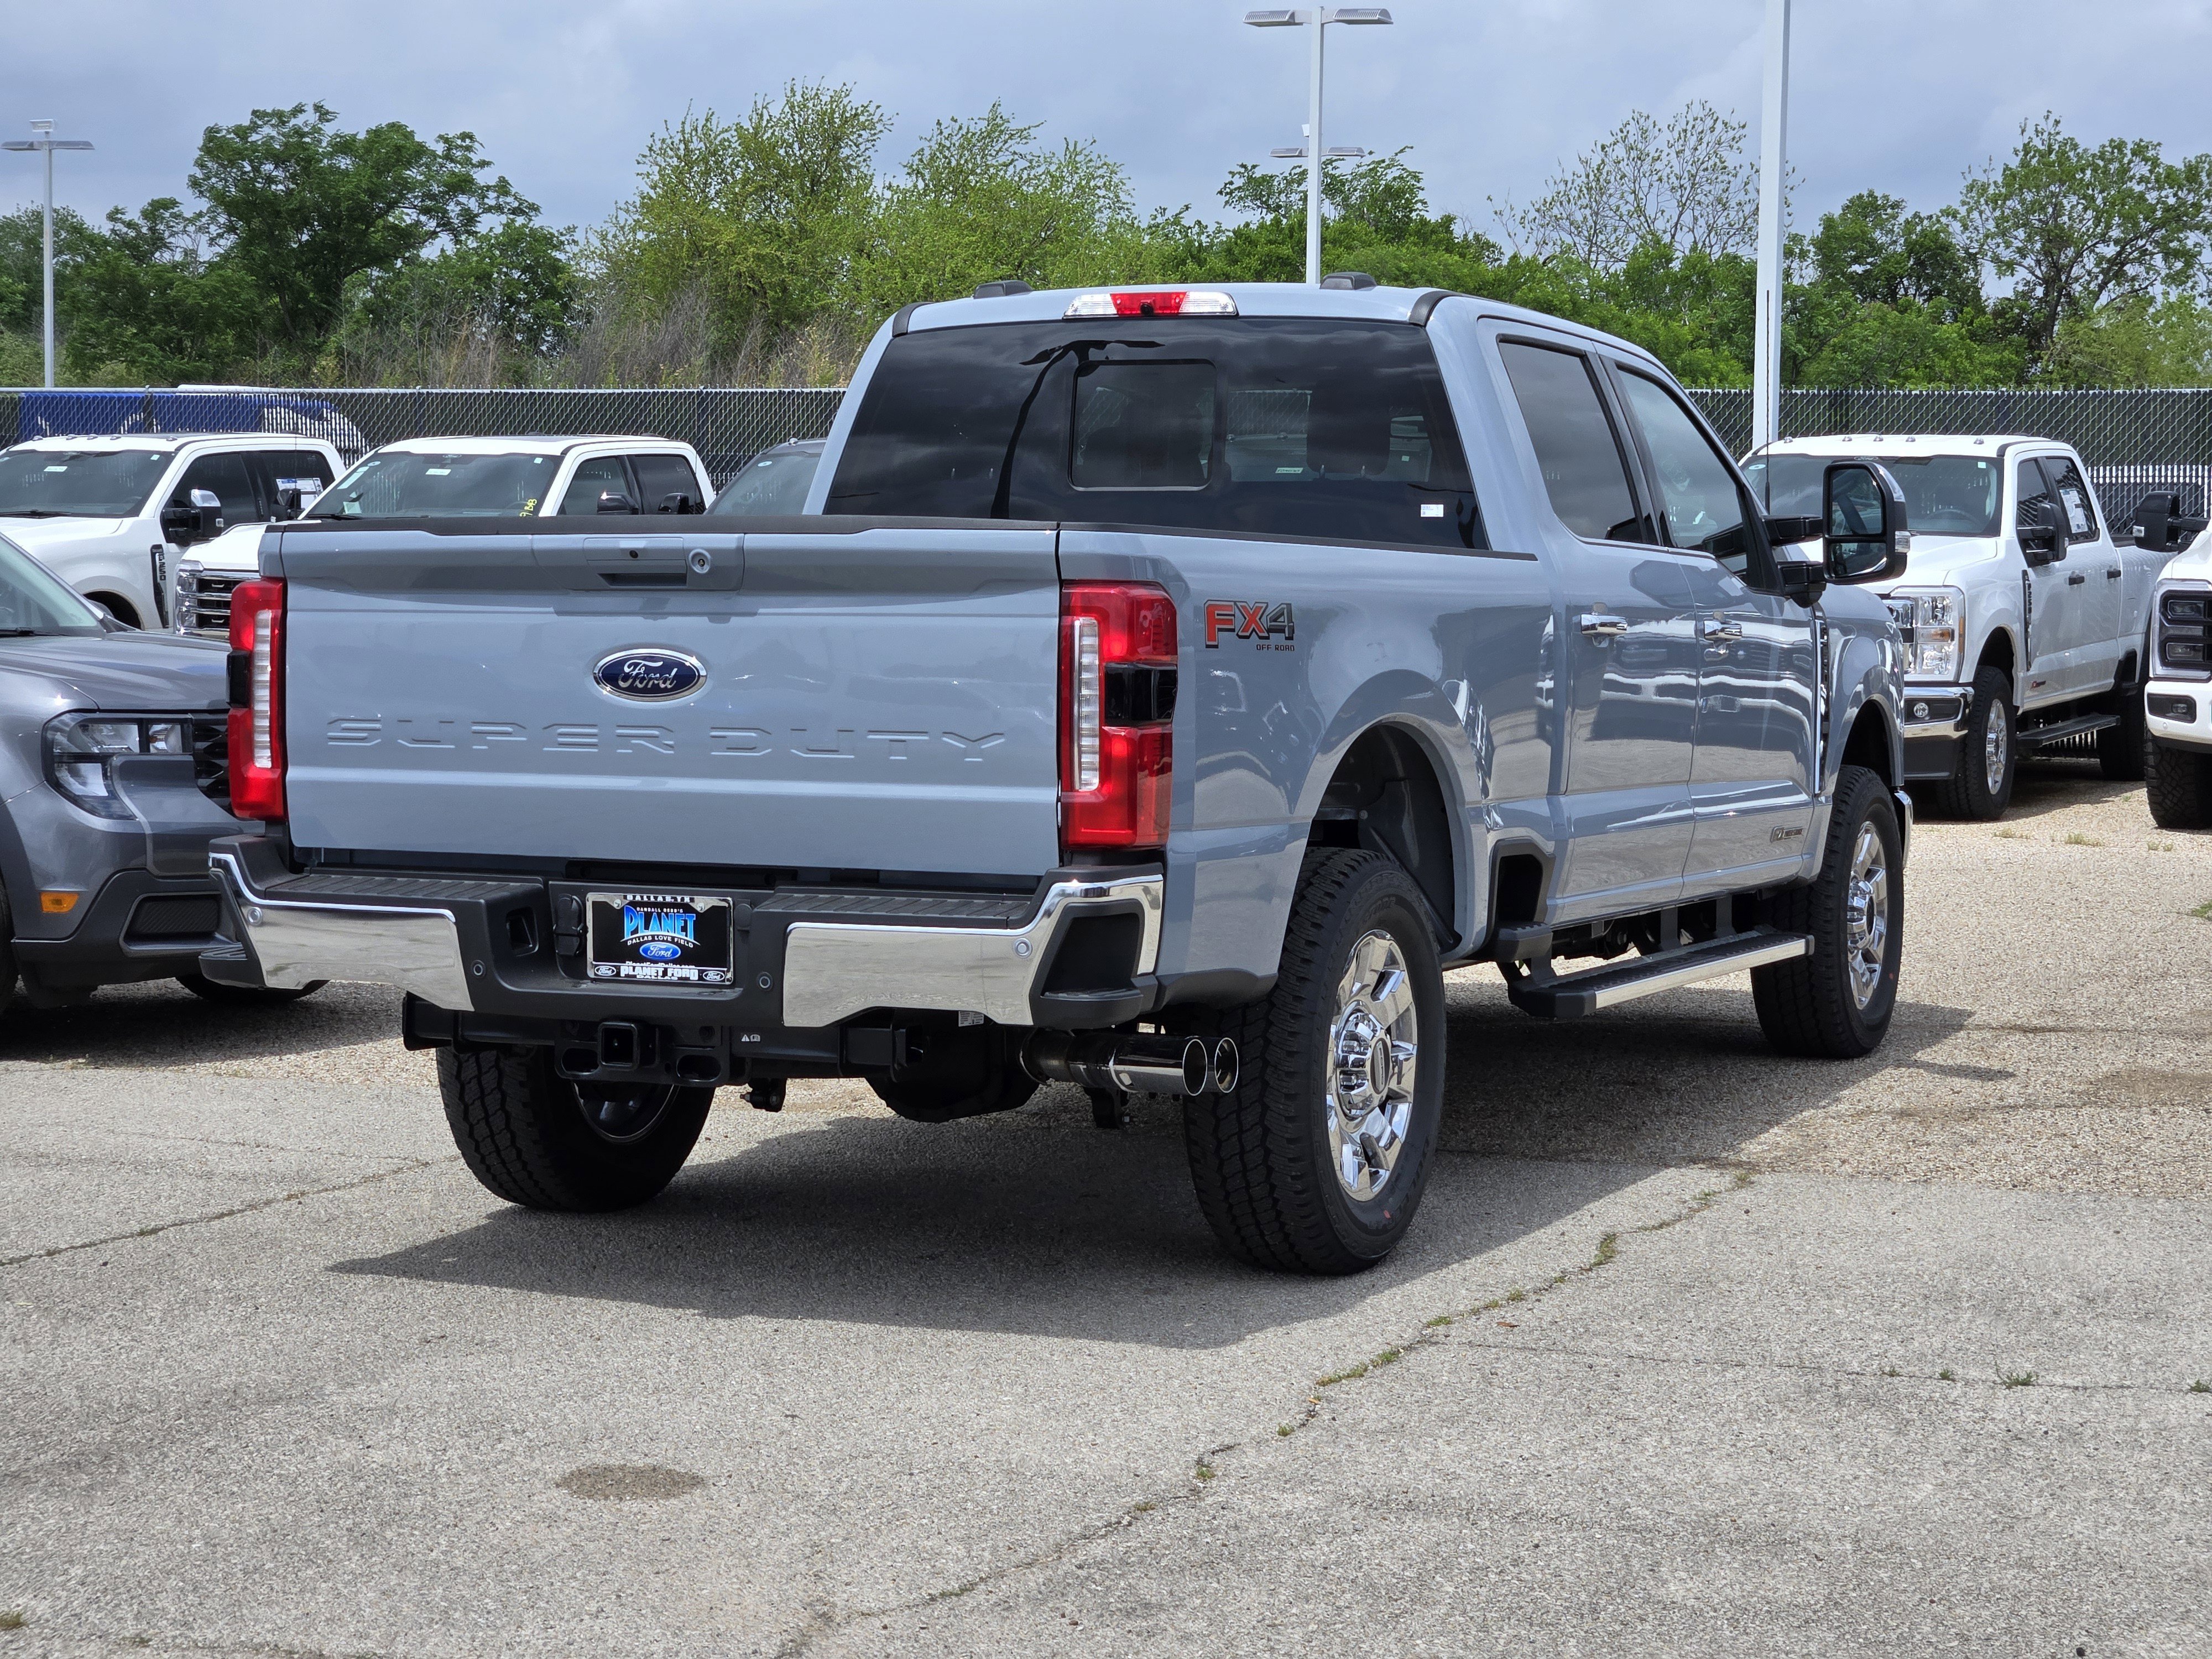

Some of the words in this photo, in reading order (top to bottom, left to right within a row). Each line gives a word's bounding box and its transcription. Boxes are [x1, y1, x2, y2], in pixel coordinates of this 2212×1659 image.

[1203, 599, 1295, 649] FX4
[618, 660, 678, 688] Ford
[327, 718, 675, 755] SUPER
[710, 726, 1005, 762] DUTY
[623, 905, 696, 940] PLANET
[627, 935, 653, 946] DALLAS
[674, 937, 693, 948] FIELD
[647, 944, 672, 957] Ford
[620, 966, 664, 977] PLANET
[667, 968, 698, 980] FORD
